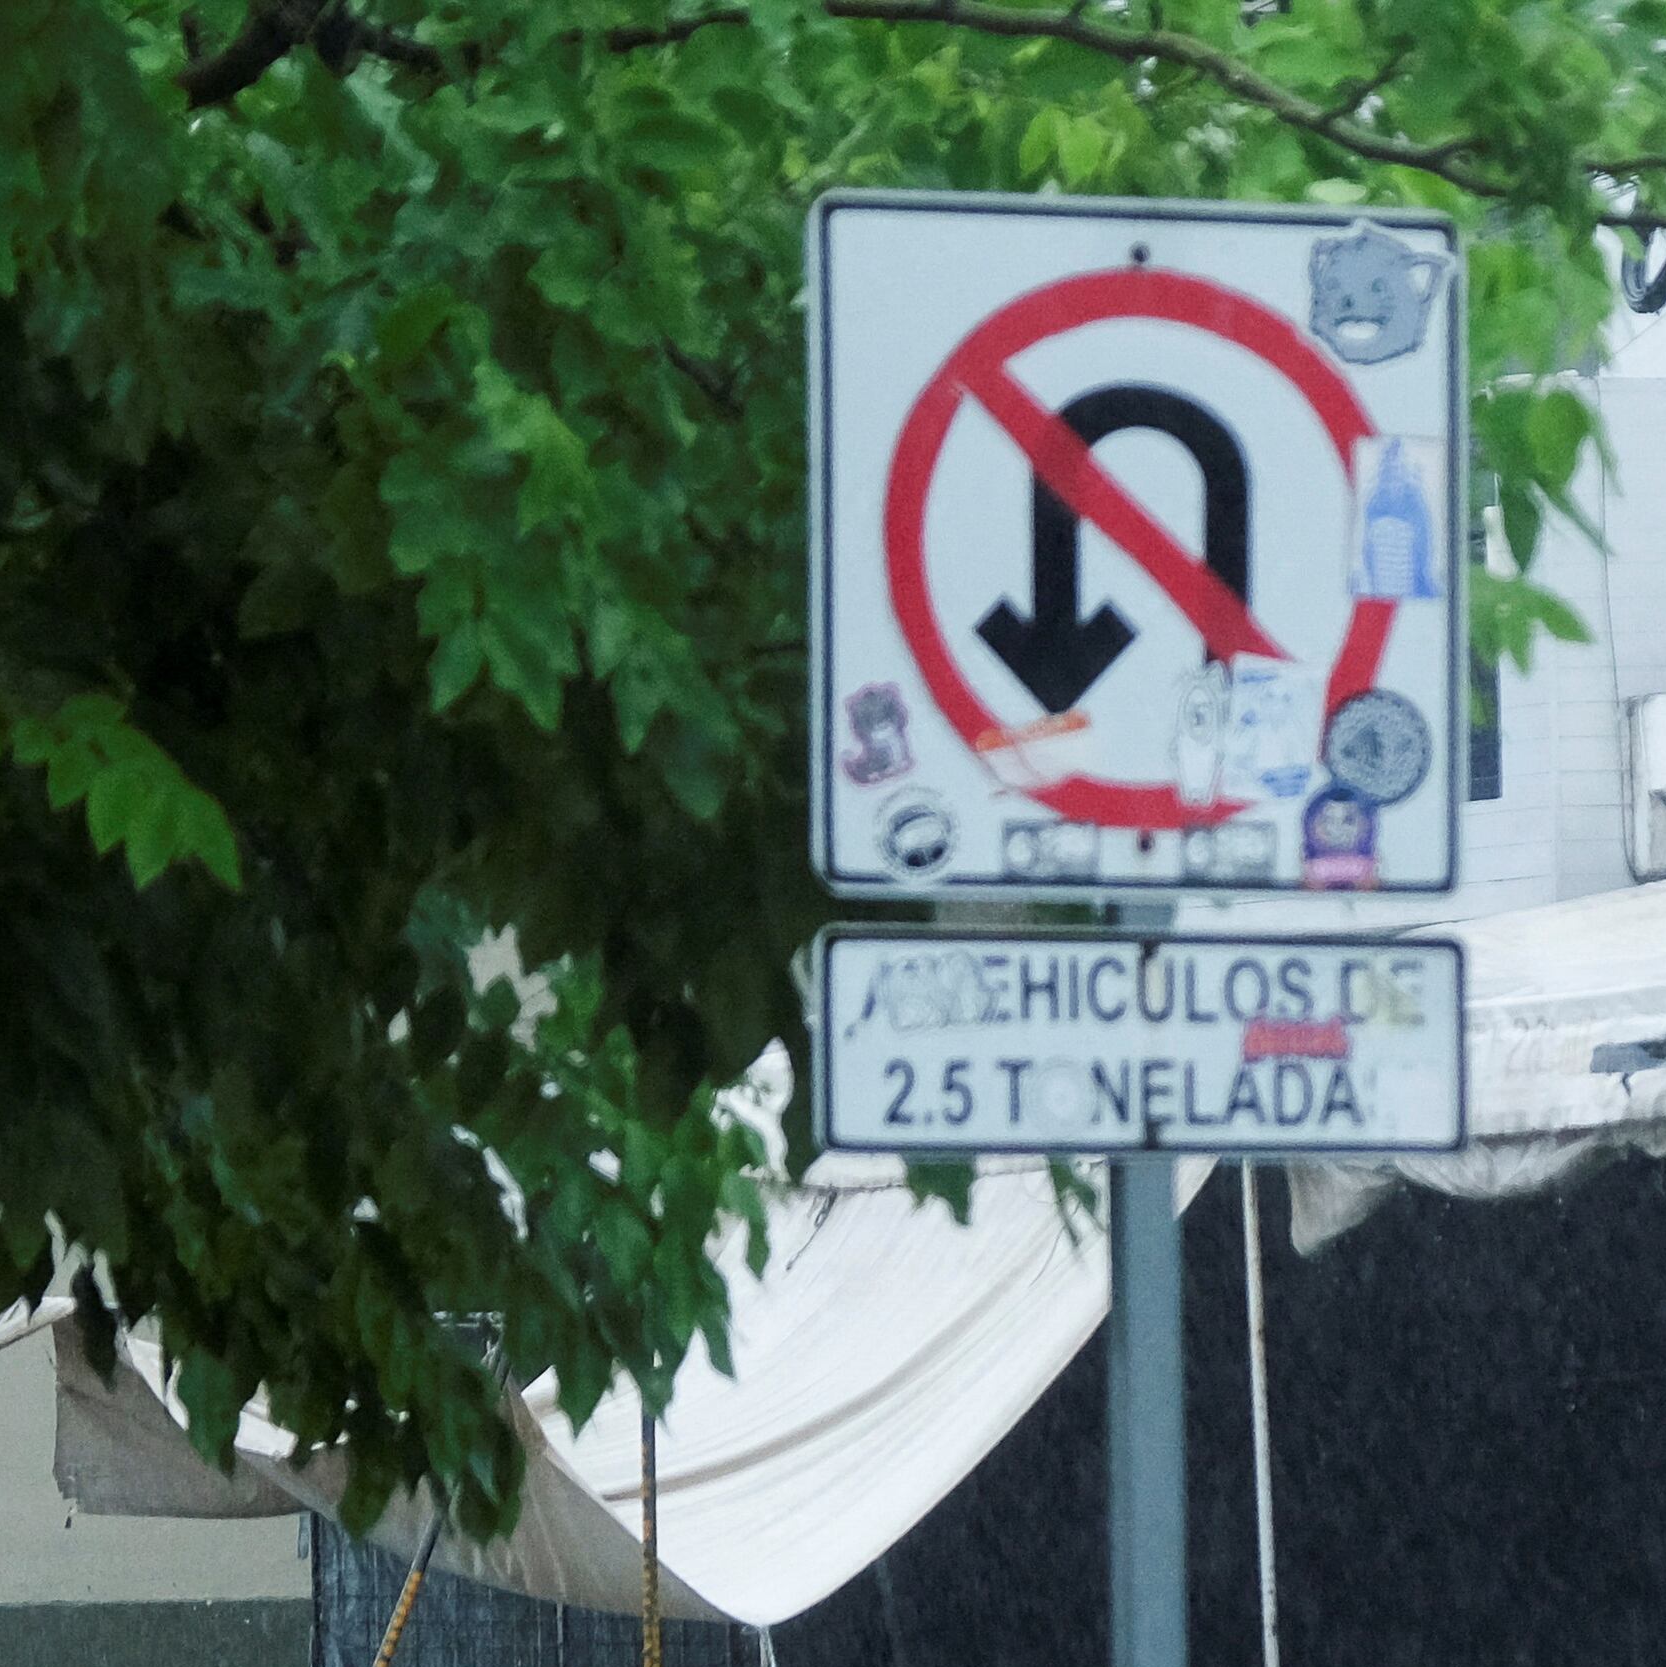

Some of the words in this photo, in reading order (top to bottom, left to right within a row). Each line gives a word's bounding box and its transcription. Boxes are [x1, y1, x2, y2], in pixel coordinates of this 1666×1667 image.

[929, 954, 1314, 1024] EHICULOS
[884, 1057, 973, 1127] 2.5
[996, 1058, 1375, 1128] TNELADA
